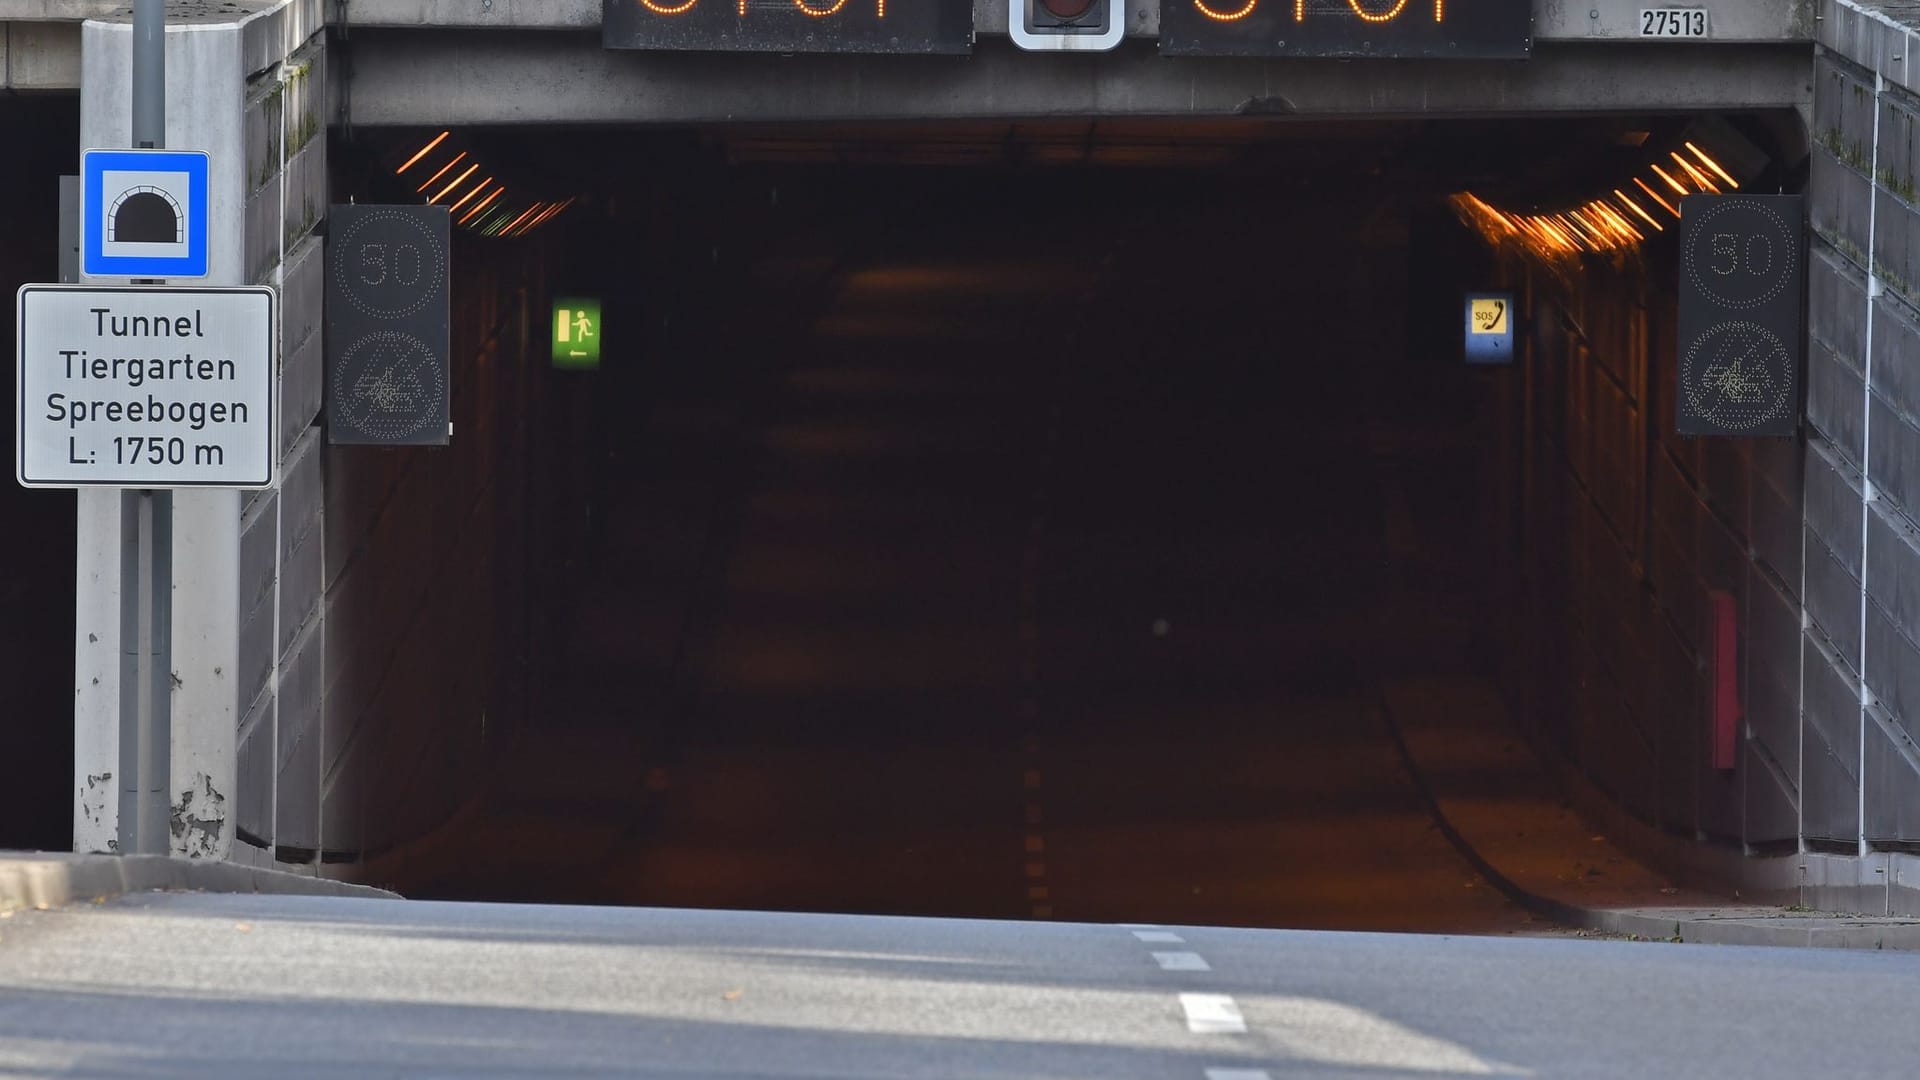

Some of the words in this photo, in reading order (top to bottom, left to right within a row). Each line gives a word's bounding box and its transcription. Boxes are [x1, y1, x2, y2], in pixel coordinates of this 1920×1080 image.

[1642, 10, 1705, 36] 27513
[360, 243, 421, 287] 50
[1710, 233, 1772, 276] 50
[90, 308, 204, 337] Tunnel
[1474, 310, 1495, 322] SOS
[59, 350, 235, 387] Tiergarten
[46, 393, 248, 430] Spreebogen
[69, 436, 96, 464] L:
[113, 437, 185, 465] 1750
[194, 443, 224, 465] m
